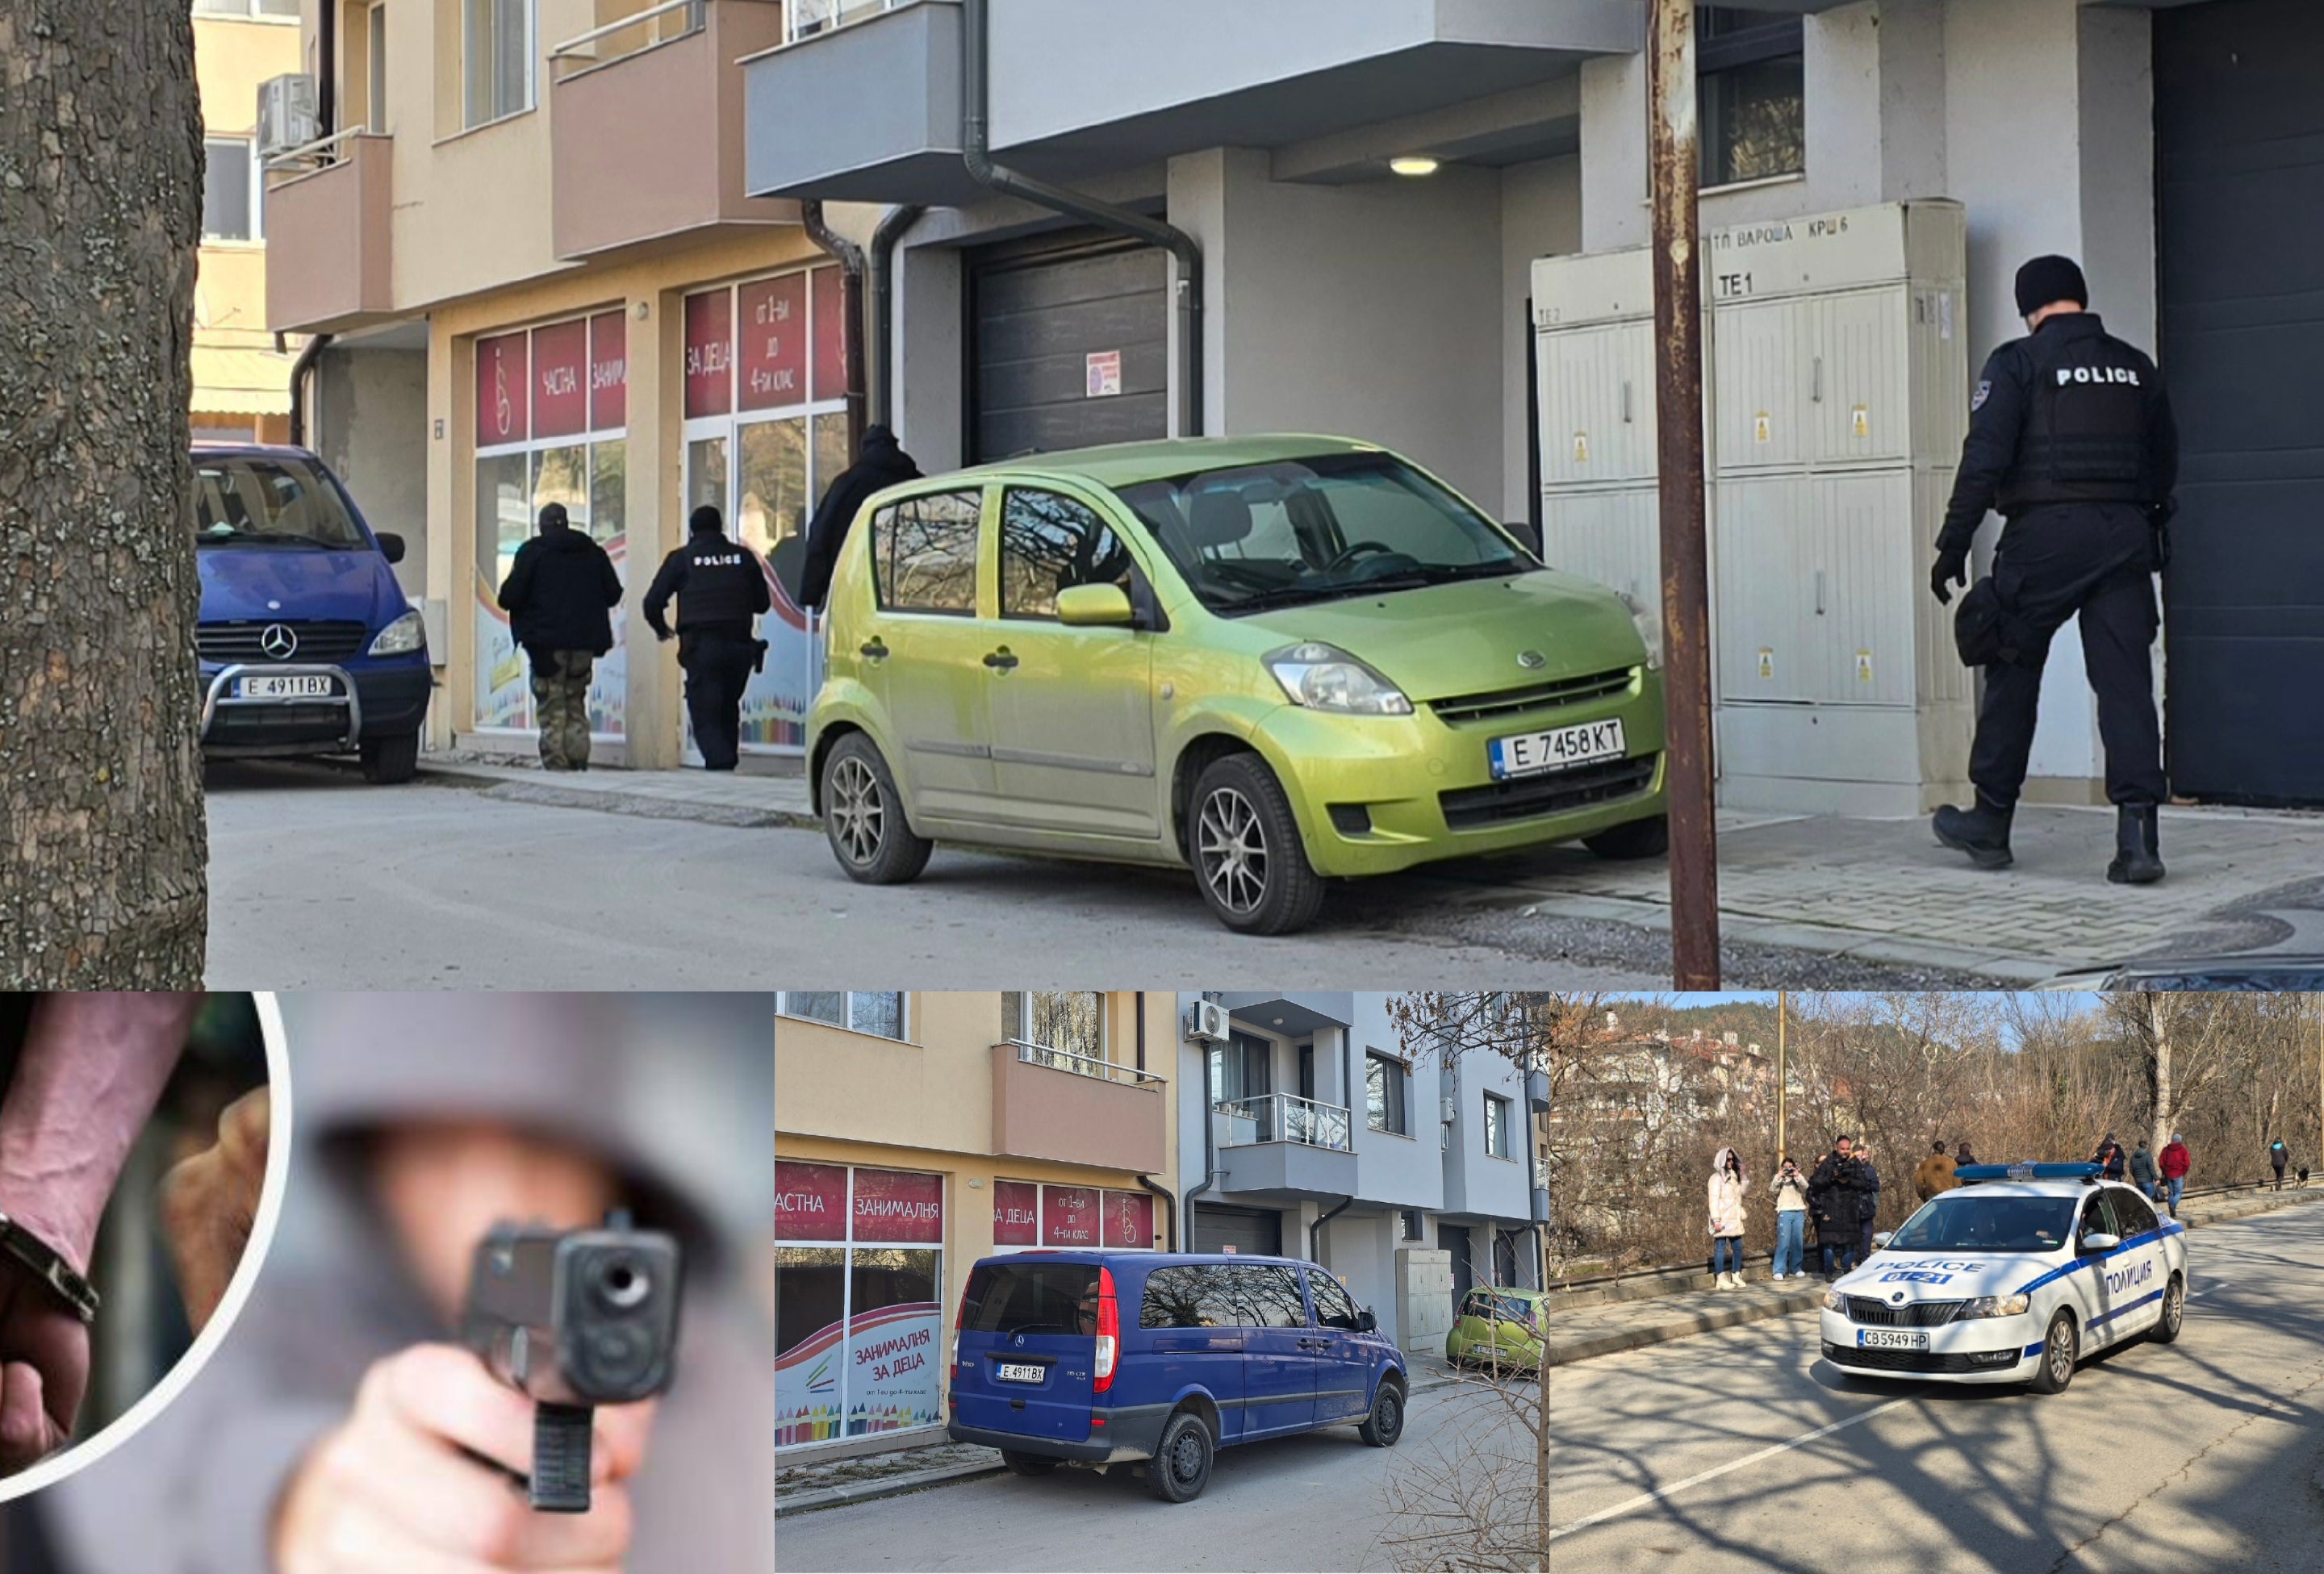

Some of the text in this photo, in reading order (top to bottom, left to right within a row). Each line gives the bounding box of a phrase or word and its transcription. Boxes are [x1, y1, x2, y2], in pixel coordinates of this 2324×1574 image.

[2057, 367, 2140, 386] POLICE
[694, 553, 741, 566] POLICE
[855, 1198, 939, 1219] ЗАНИМАЛНЯ
[993, 1208, 1035, 1226] А ДЕЦА
[1875, 1260, 1986, 1272] POLICE
[2106, 1259, 2153, 1297] ПОЛИЦИЯ
[855, 1329, 930, 1365] ЗАНИМАЛНЯ
[872, 1364, 890, 1381] ЗА
[893, 1352, 926, 1378] ДЕЦА
